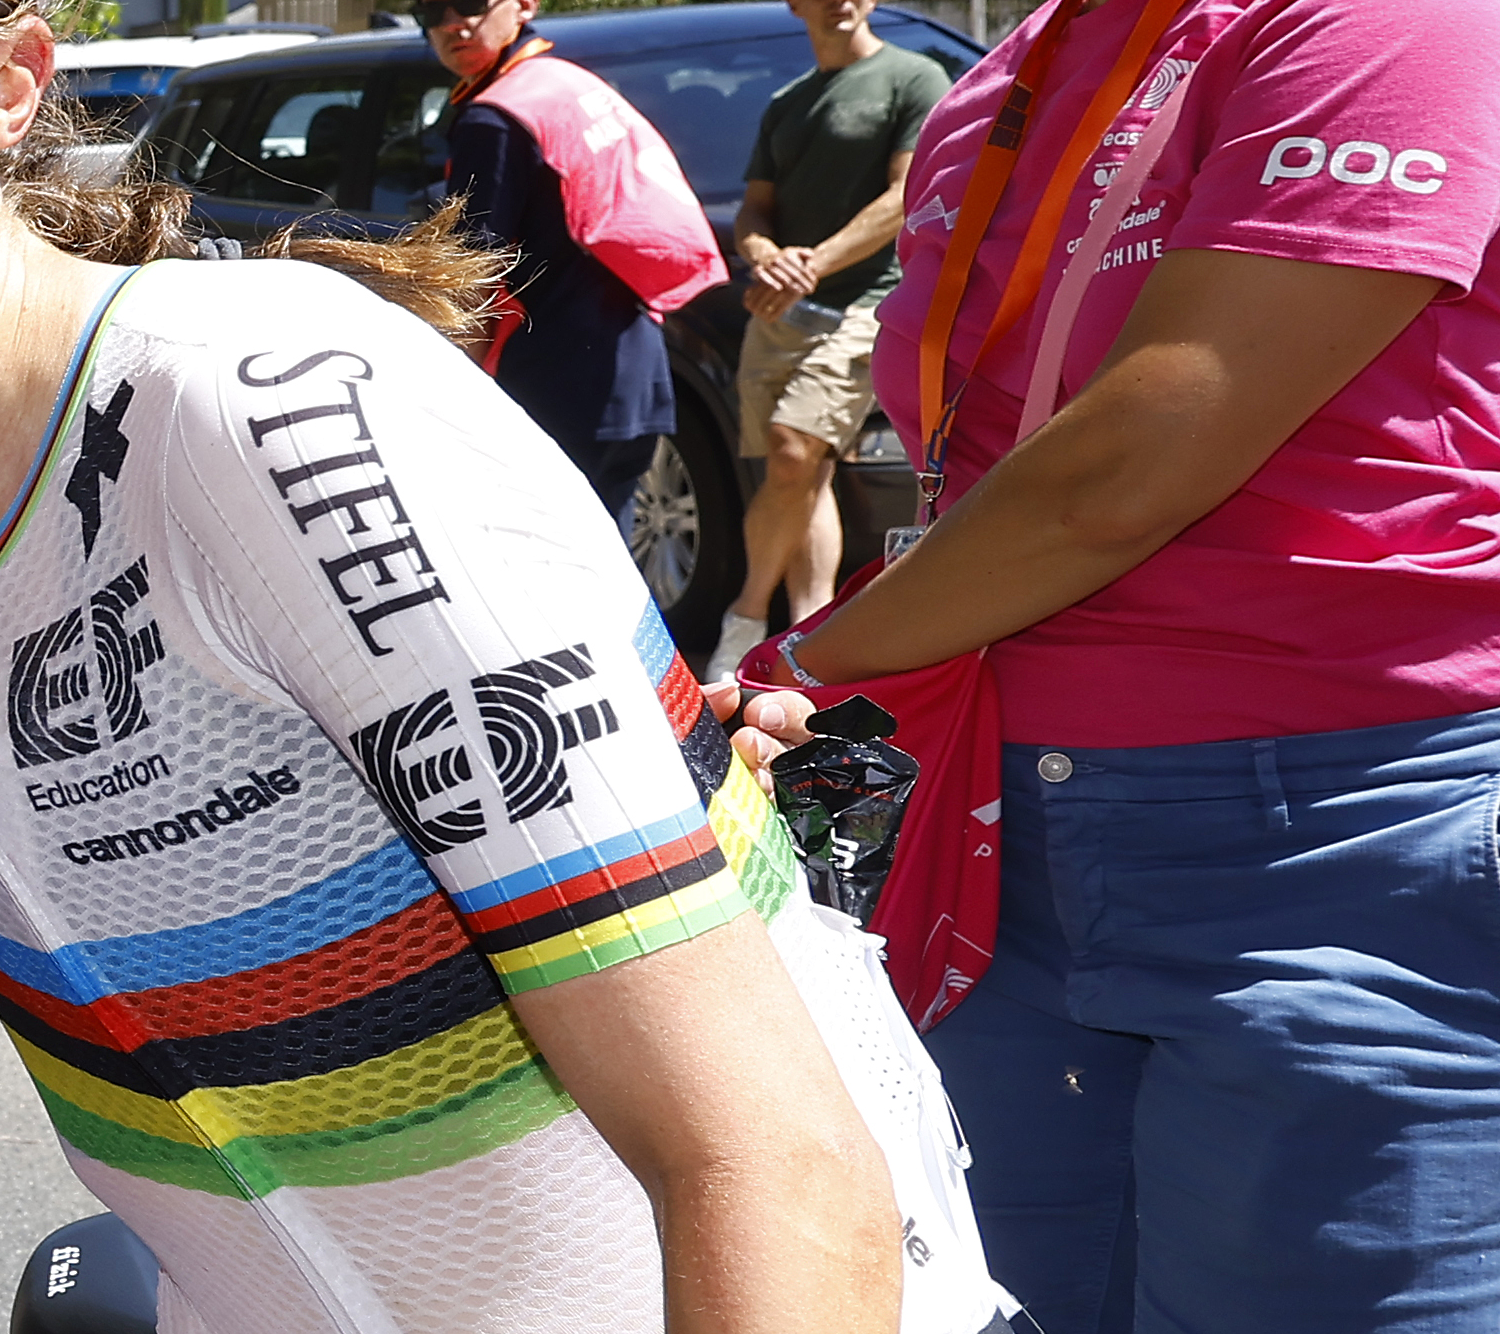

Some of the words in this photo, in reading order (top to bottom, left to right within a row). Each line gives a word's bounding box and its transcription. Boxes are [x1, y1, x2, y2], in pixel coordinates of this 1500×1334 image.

[1258, 136, 1448, 195] poc
[237, 350, 452, 656] STIFEL
[26, 750, 171, 813] Education
[62, 764, 300, 866] cannondale
